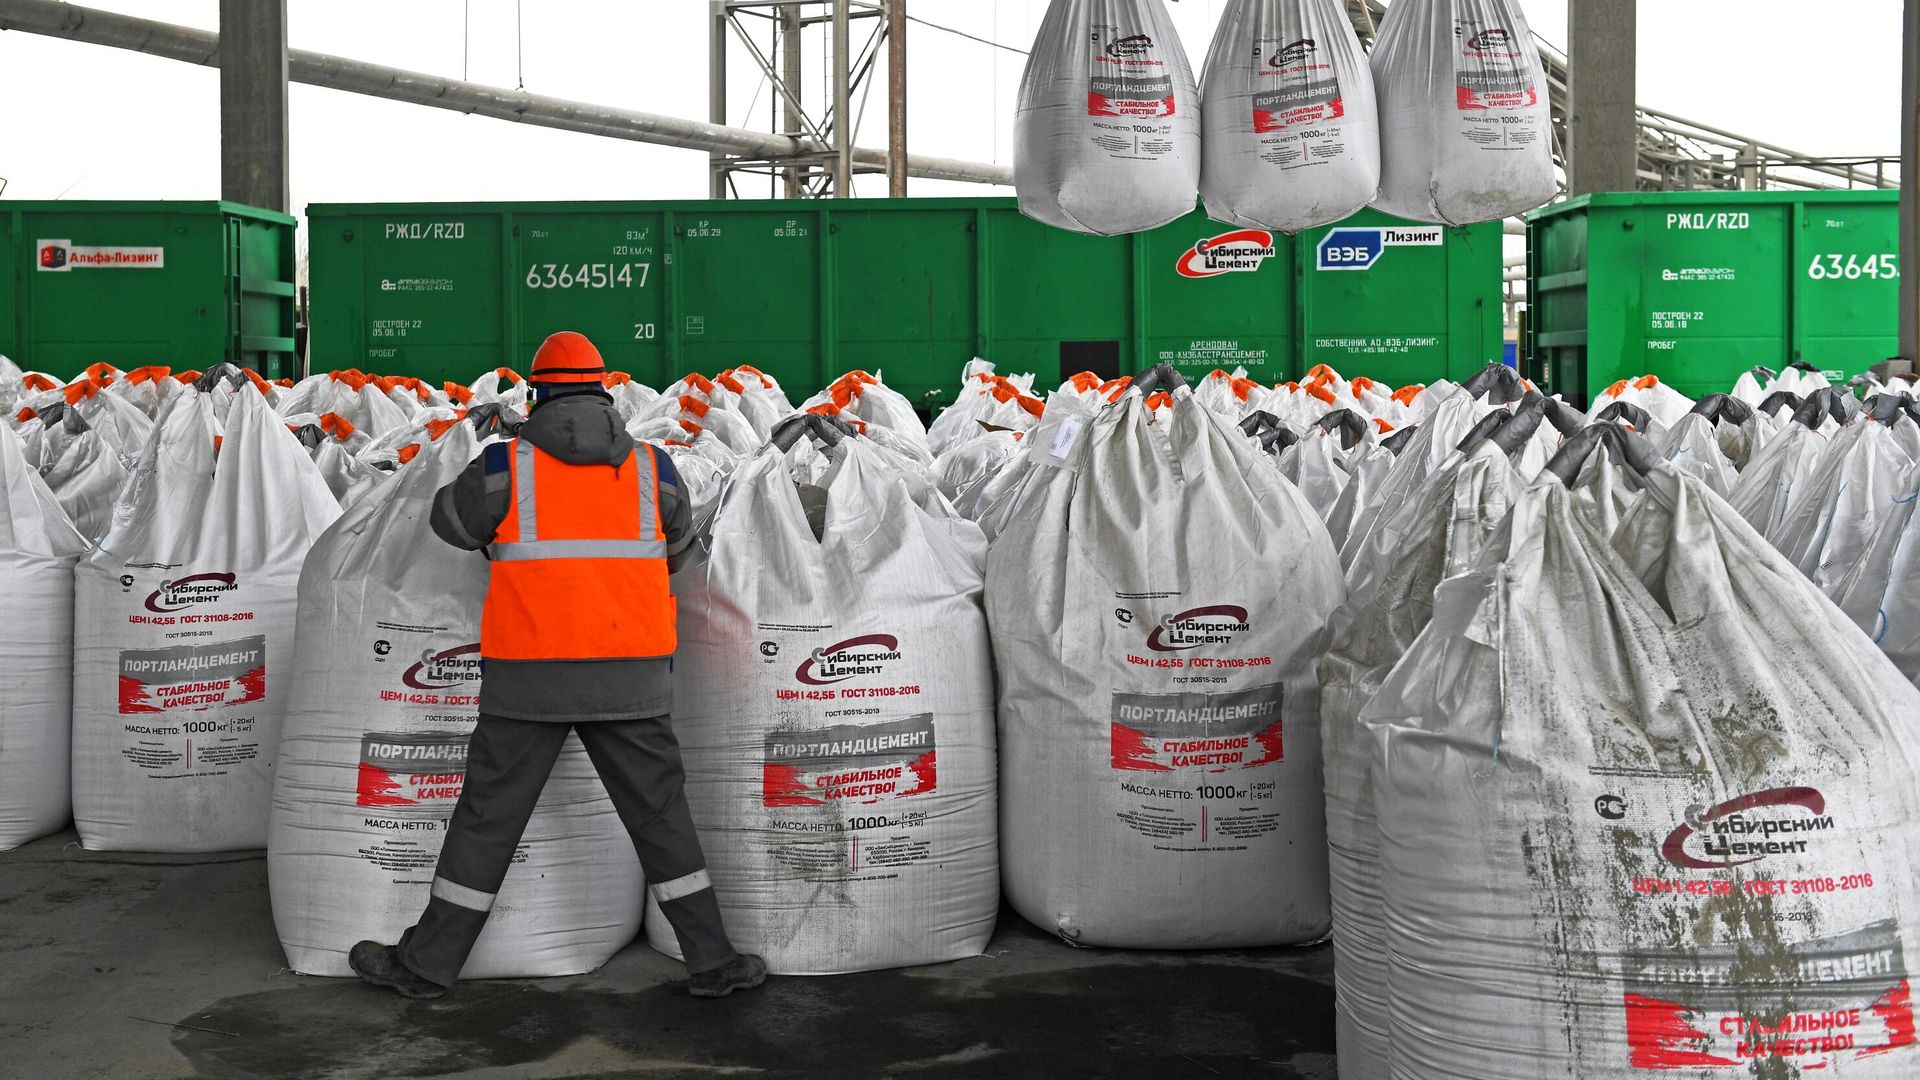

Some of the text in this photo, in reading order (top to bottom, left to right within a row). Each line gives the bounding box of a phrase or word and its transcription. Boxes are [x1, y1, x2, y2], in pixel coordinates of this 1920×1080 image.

[1093, 82, 1170, 93] ПОРТЛАНДЦЕМЕНТ
[1256, 85, 1337, 106] ПОРТЛАНДЦЕМЕНТ
[1280, 104, 1325, 119] СТАБИЛЬНОЕ
[1285, 113, 1322, 125] КАЧЕСТВО!
[1667, 213, 1749, 229] РЖД/RZD
[385, 222, 465, 239] РЖД/RZD
[1384, 230, 1439, 243] Лизинг
[613, 246, 628, 255] 120
[1196, 239, 1275, 257] Сибирский
[1327, 247, 1370, 262] ВЭБ
[69, 251, 160, 265] Альфа-Лизинг
[1205, 252, 1258, 269] Цемент
[1808, 253, 1900, 280] 63645
[526, 262, 650, 288] 63645147
[1652, 311, 1704, 320] ПОСТРОЕН 22
[373, 320, 422, 329] ПОСТРОЕН 22
[634, 323, 655, 339] 20
[1190, 340, 1238, 349] АРЕНДОВАН
[1315, 338, 1367, 347] СОБСТВЕННИК
[1370, 338, 1381, 347] АО
[1648, 341, 1676, 350] ПРОБЕГ
[369, 349, 397, 358] ПРОБЕГ
[160, 579, 238, 596] Сибирский
[165, 594, 220, 606] Цемент
[129, 615, 147, 625] ЦЕМ
[180, 615, 203, 624] ГОСТ
[203, 611, 254, 623] 31108-2016
[1161, 613, 1249, 634] Сибирский
[1170, 630, 1231, 644] Цемент
[124, 650, 258, 673] ПОРТЛАНДЦЕМЕНТ
[811, 647, 902, 665] Сибирский
[1127, 654, 1149, 667] ЦЕМ
[1189, 658, 1215, 668] ГОСТ
[1216, 656, 1271, 668] 31108-2016
[427, 667, 483, 680] Цемен
[820, 664, 883, 677] Цемент
[1173, 676, 1227, 684] ГОСТ 30515-2013
[157, 680, 231, 697] СТАБИЛЬНОЕ
[776, 690, 799, 700] ЦЕМ
[841, 688, 867, 698] ГОСТ
[868, 685, 920, 697] 31108-2016
[163, 692, 225, 708] КАЧЕСТВО!
[380, 690, 402, 702] ЦЕМ
[445, 695, 472, 705] ГОСТ
[843, 708, 880, 716] 30515-2013
[1120, 701, 1277, 723] ПОРТЛАНДЦЕМЕНТ
[125, 724, 151, 734] МАССА
[152, 727, 180, 736] НЕТТО:
[773, 730, 928, 757] ПОРТЛАНДЦЕМЕНТ
[1163, 737, 1248, 753] СТАБИЛЬНОЕ
[1172, 752, 1243, 767] КАЧЕСТВО!
[409, 773, 465, 786] СТАБИЛ
[816, 766, 902, 787] СТАБИЛЬНОЕ
[416, 787, 462, 800] КАЧЕС
[824, 782, 896, 800] КАЧЕСТВО!
[1121, 782, 1156, 797] МАССА
[1159, 789, 1193, 800] НЕТТО:
[365, 818, 437, 831] МАССА НЕТТО:
[772, 820, 808, 830] МАССА
[1684, 804, 1835, 839] Сибирский
[1703, 835, 1807, 856] Цемент
[1743, 880, 1787, 896] ГОСТ
[1790, 872, 1874, 894] 31108-2016
[1736, 1034, 1855, 1059] КАЧЕСТВО!
